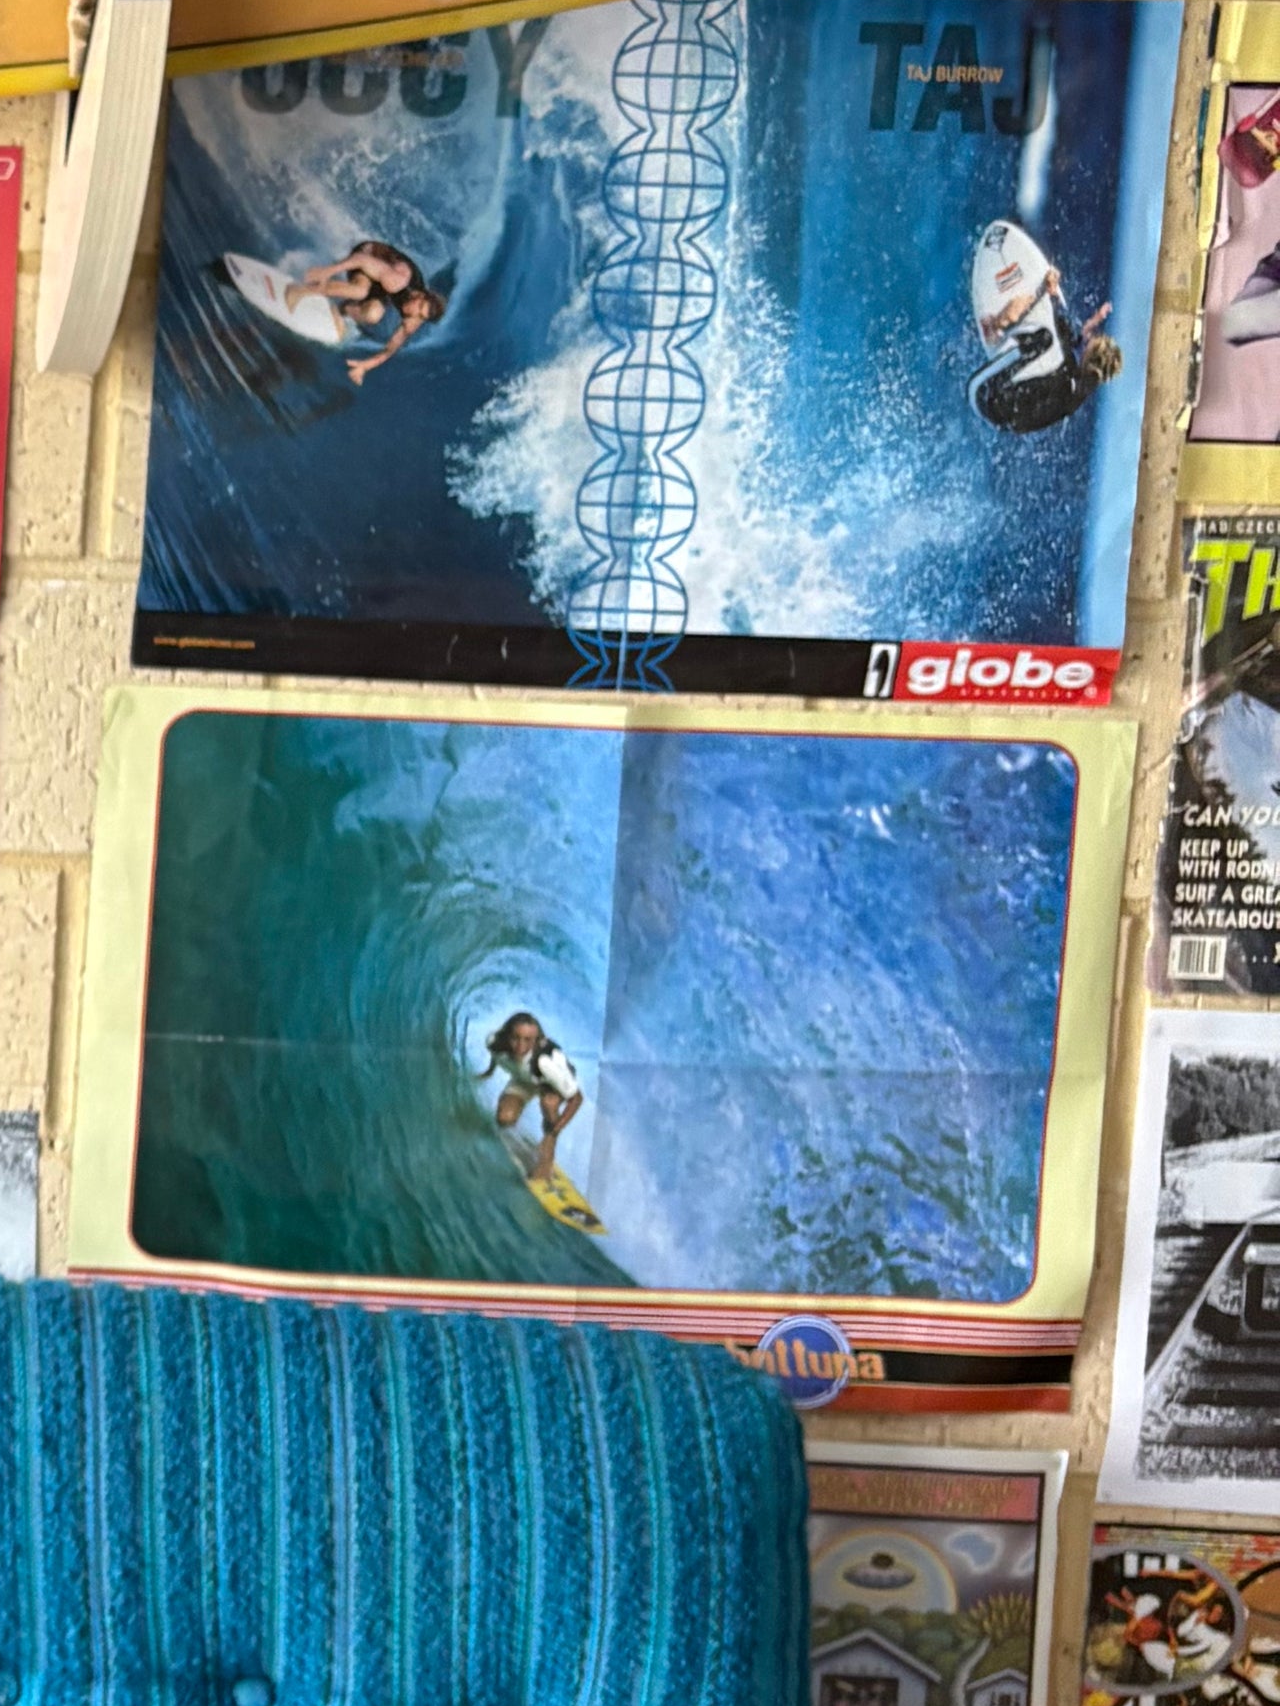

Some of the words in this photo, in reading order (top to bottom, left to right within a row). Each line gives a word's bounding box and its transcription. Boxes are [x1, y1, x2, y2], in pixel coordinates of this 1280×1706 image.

[859, 21, 1051, 134] TAJ
[907, 64, 932, 82] TAJ
[935, 65, 1004, 84] BURROW
[1236, 520, 1280, 534] CZEC
[907, 649, 1095, 695] globe
[1183, 804, 1231, 827] CAN
[1179, 839, 1221, 858] KEEP
[1226, 839, 1249, 859] UP
[1178, 859, 1221, 879] WITH
[1174, 883, 1217, 903] SURF
[1221, 884, 1235, 903] A
